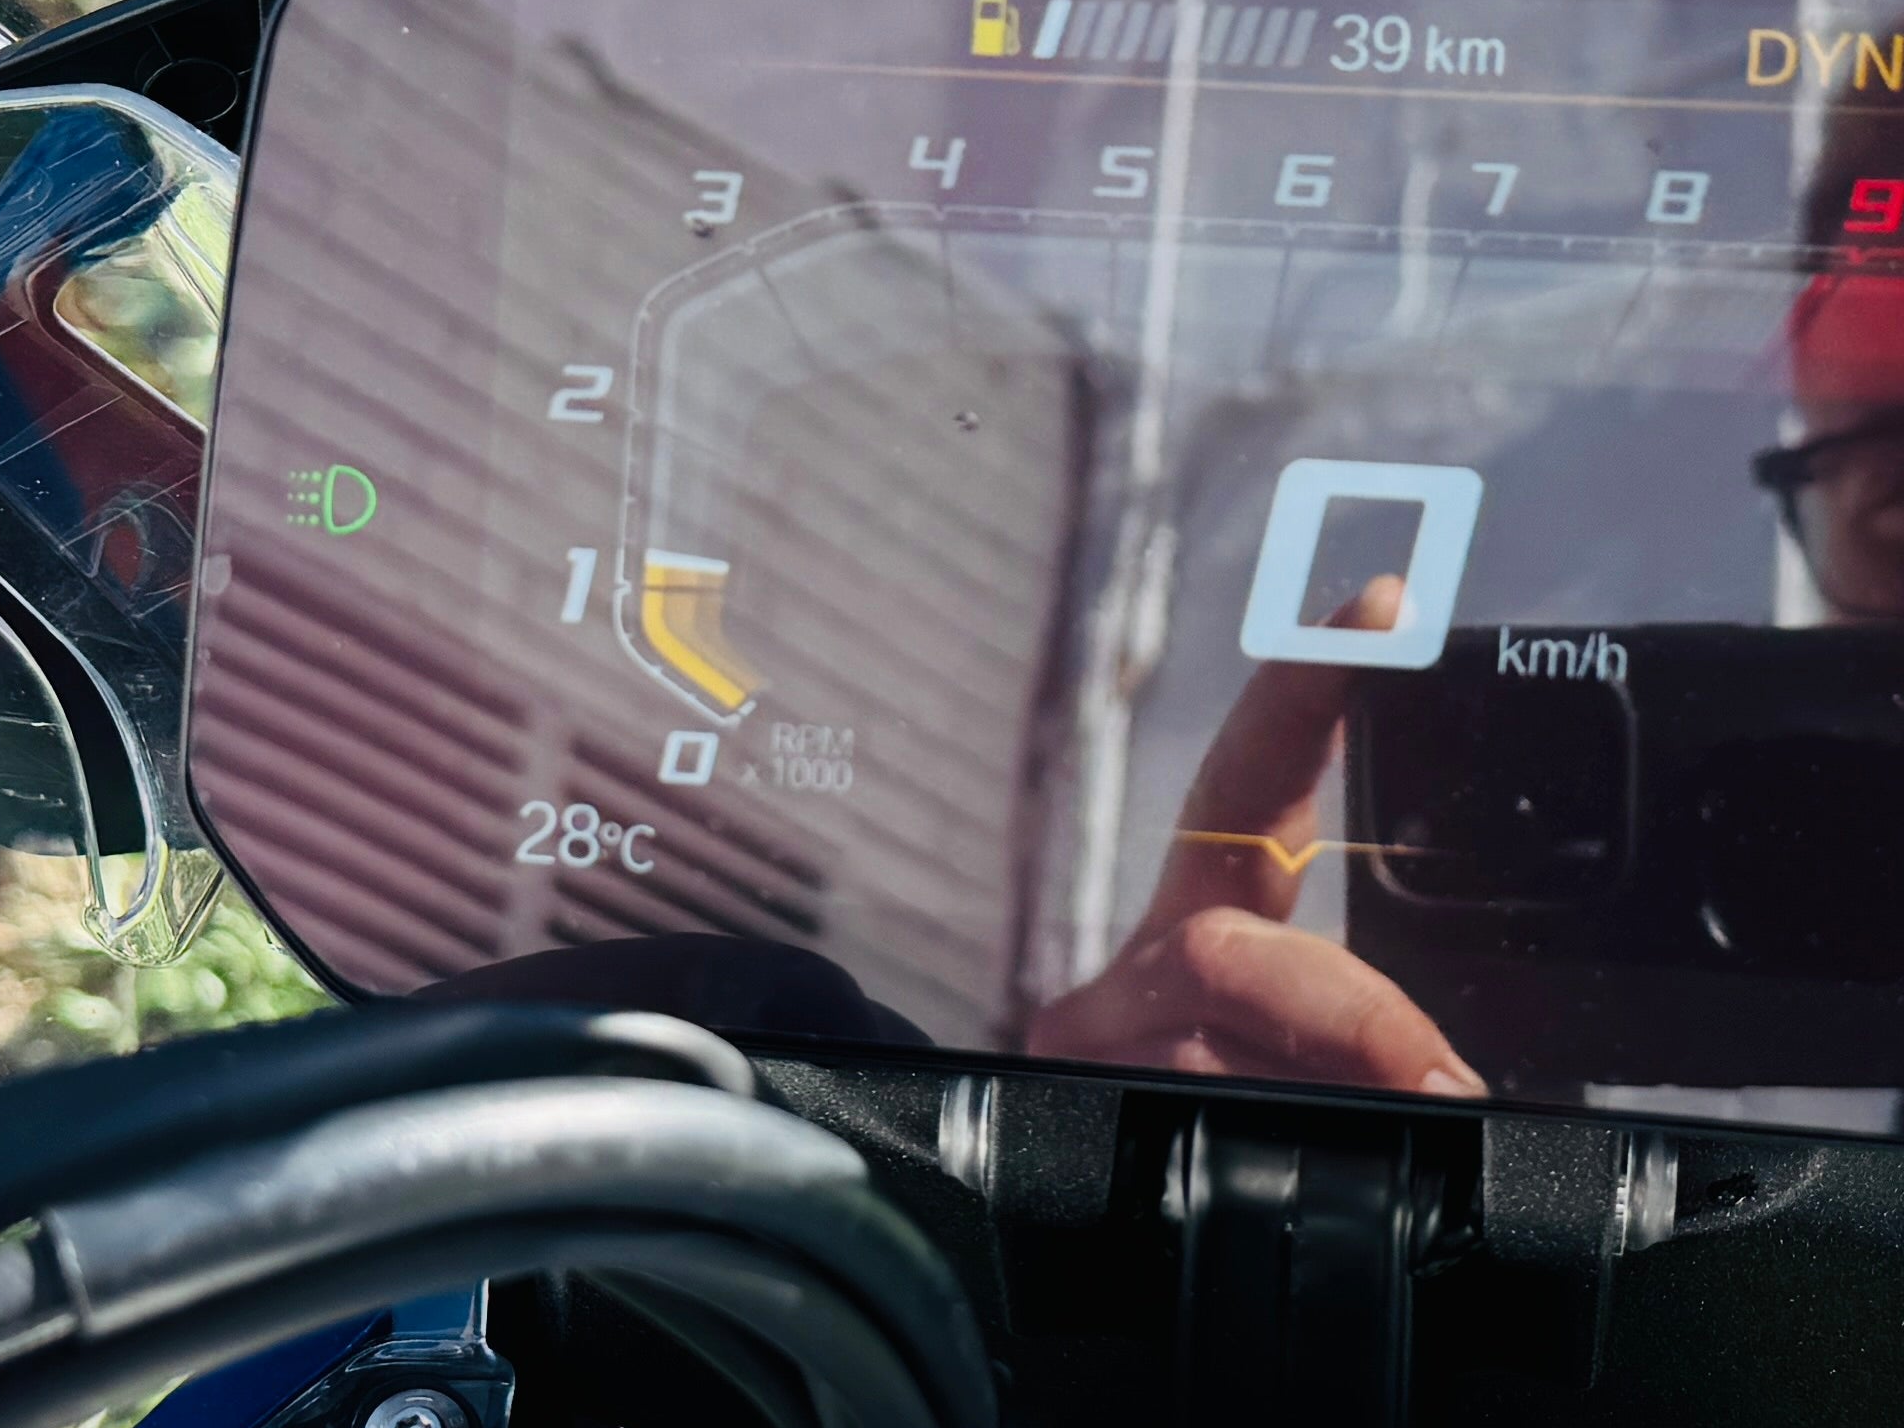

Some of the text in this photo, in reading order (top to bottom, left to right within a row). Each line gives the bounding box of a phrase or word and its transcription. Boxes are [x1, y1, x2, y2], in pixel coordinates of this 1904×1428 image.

[1329, 13, 1507, 76] 39 km
[908, 136, 967, 189] 4
[1093, 145, 1155, 198] 5
[1274, 153, 1336, 208] 6
[1470, 162, 1520, 216] 7
[683, 170, 744, 226] 3
[1646, 171, 1710, 225] 8
[547, 364, 614, 423] 2
[560, 547, 598, 624] 1
[1240, 458, 1485, 670] 0
[1497, 627, 1629, 684] km/h
[658, 730, 719, 785] 0
[770, 722, 855, 757] RPM
[773, 756, 854, 793] 1000
